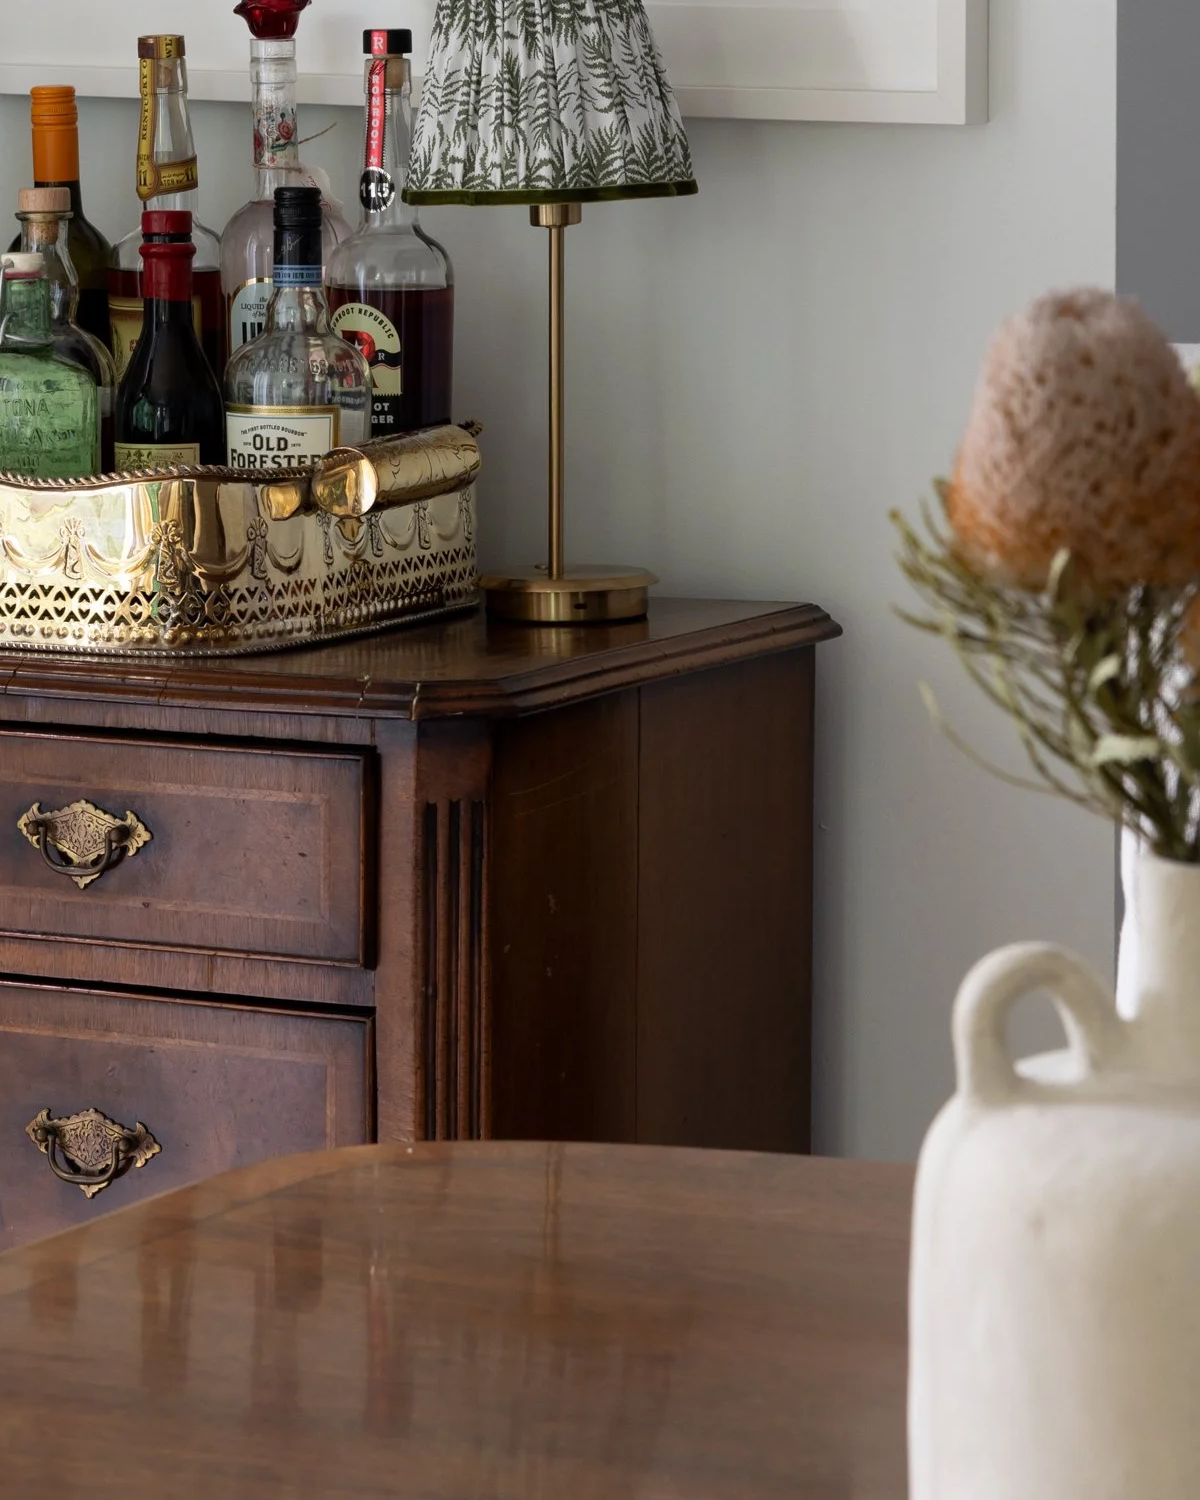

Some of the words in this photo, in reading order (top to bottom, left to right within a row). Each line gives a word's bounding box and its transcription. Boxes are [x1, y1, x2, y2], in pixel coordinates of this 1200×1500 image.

[373, 37, 383, 49] R
[141, 73, 149, 141] KENTUCKY
[371, 74, 380, 150] RONROOT
[361, 183, 389, 198] 115
[240, 303, 265, 311] LIQUID
[358, 308, 394, 339] REPUBLIC
[253, 434, 288, 451] OLD
